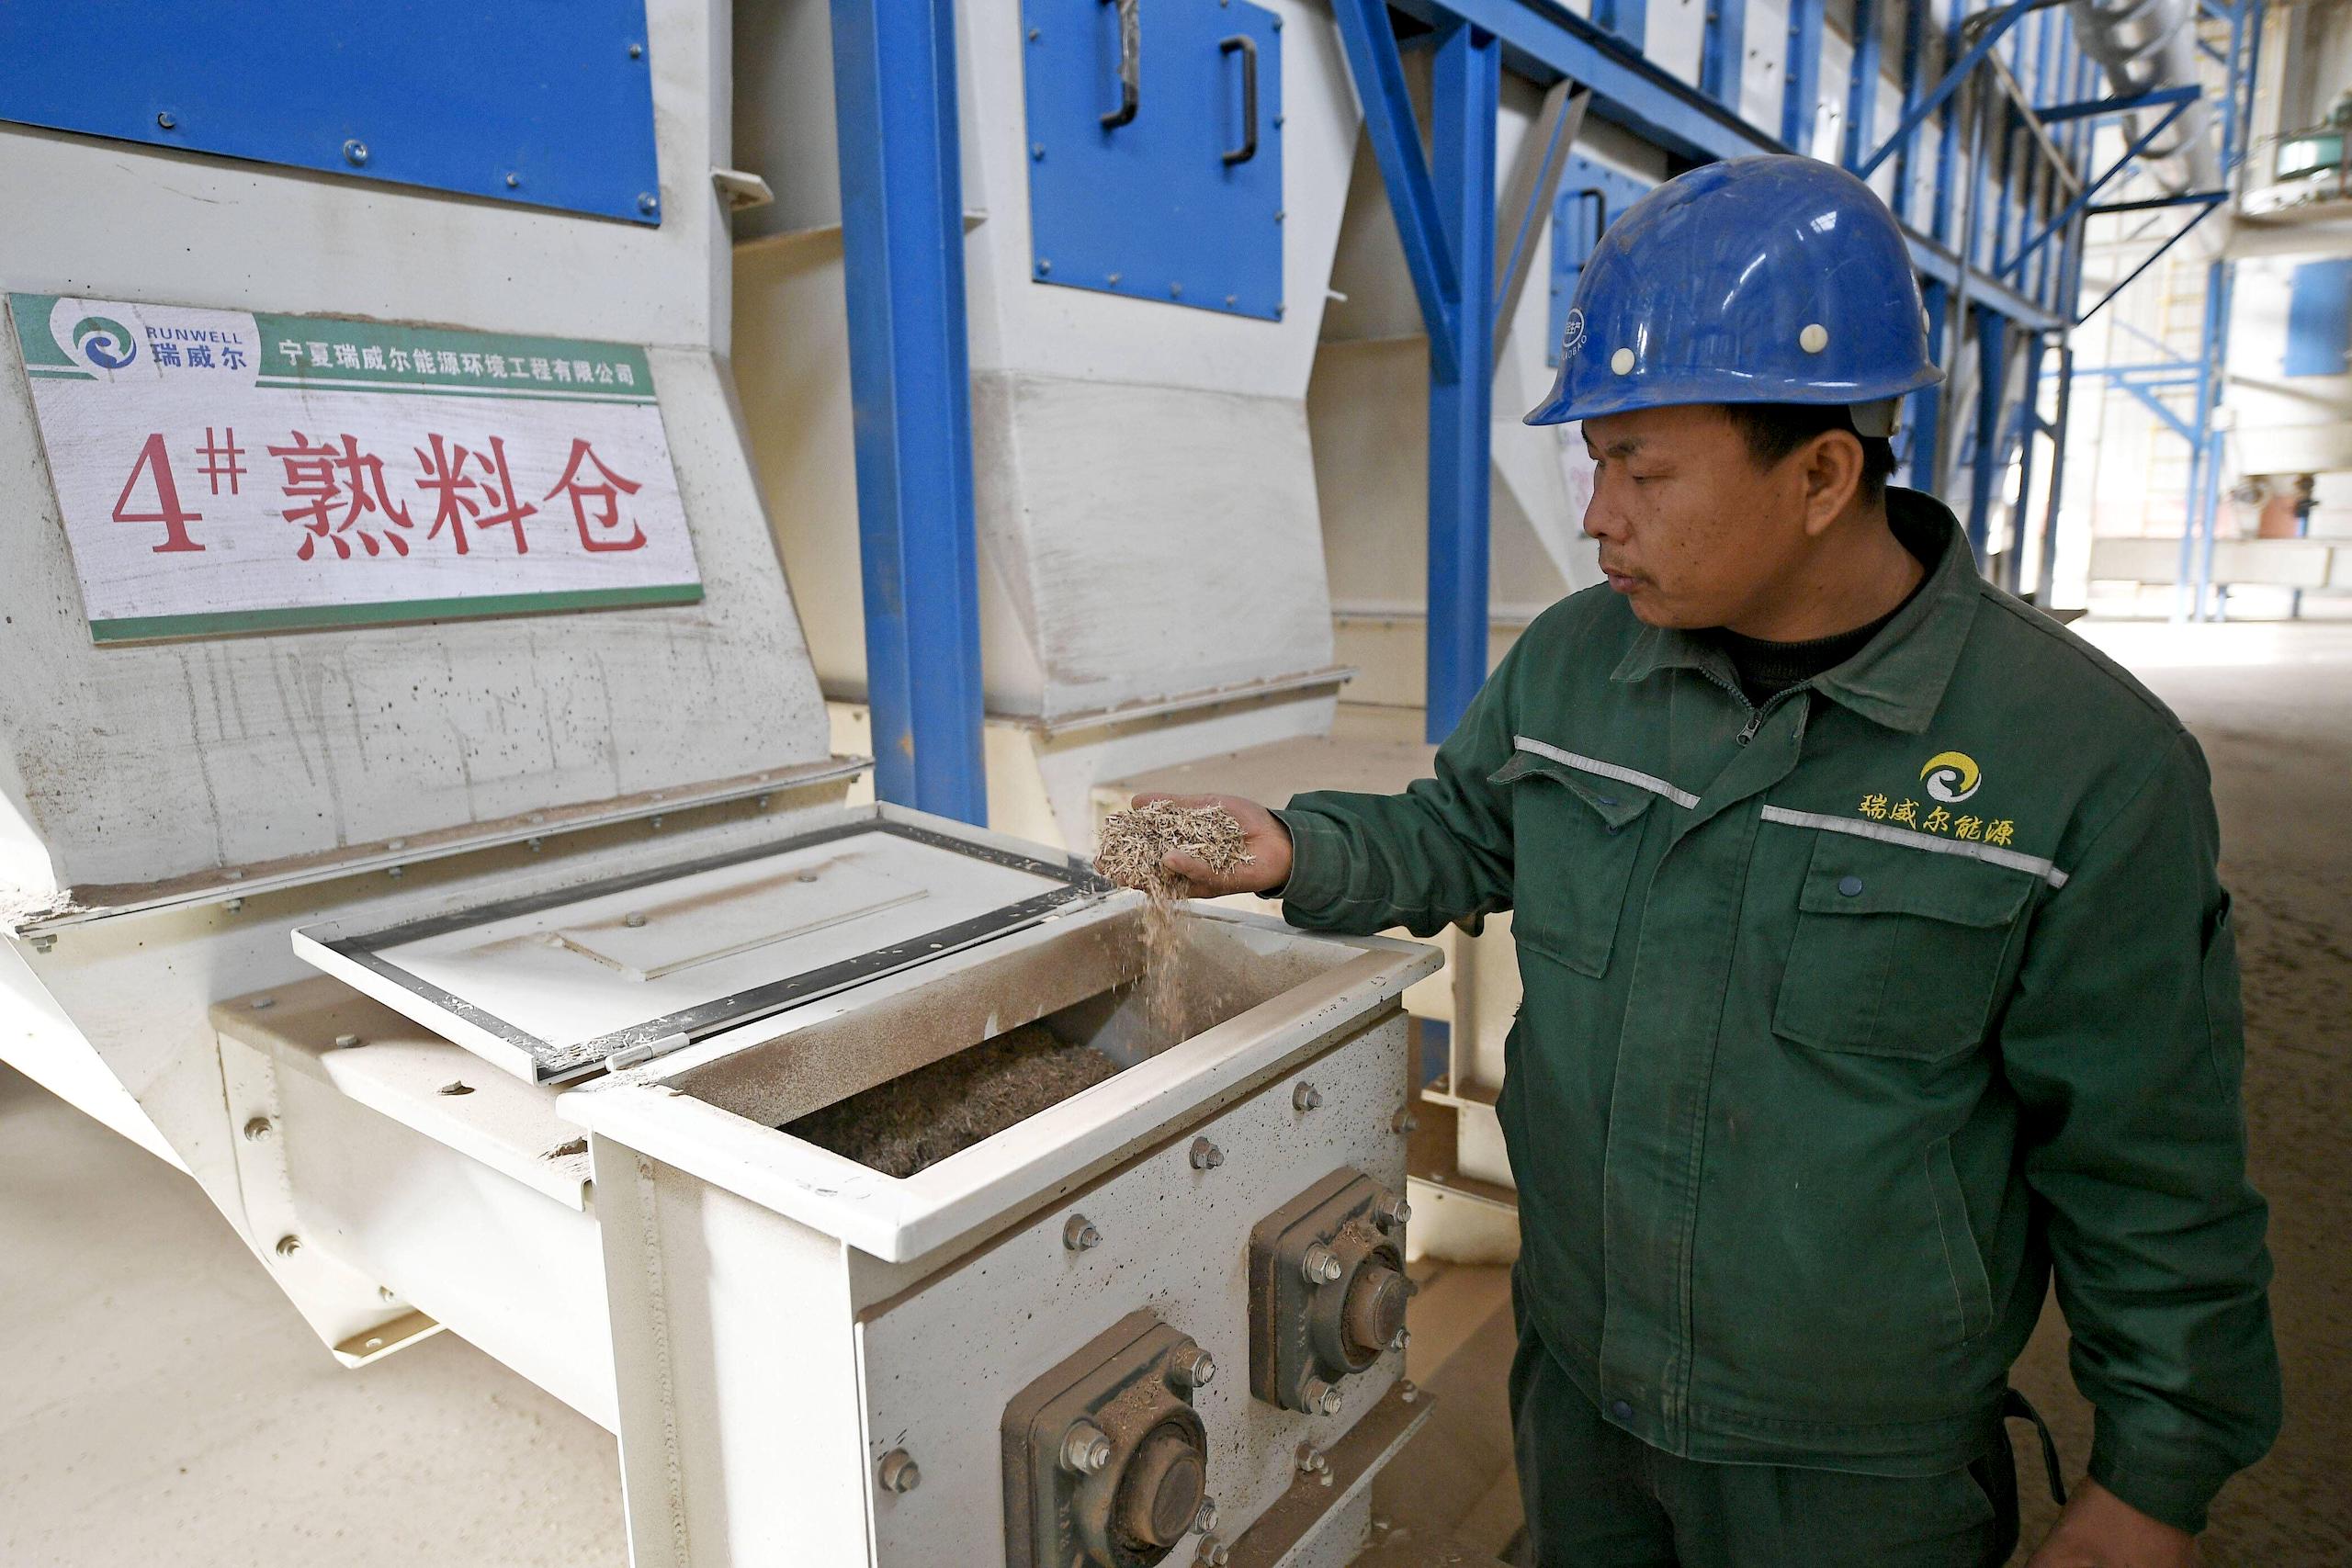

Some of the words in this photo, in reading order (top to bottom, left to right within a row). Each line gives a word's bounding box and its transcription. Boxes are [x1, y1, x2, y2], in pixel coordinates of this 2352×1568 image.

[145, 326, 243, 344] RUNWELL
[150, 343, 247, 370] 瑞威尔
[278, 339, 635, 386] 宁夏瑞威尔能源环境工程有限公司
[1857, 793, 2015, 846] 瑞威尔能源
